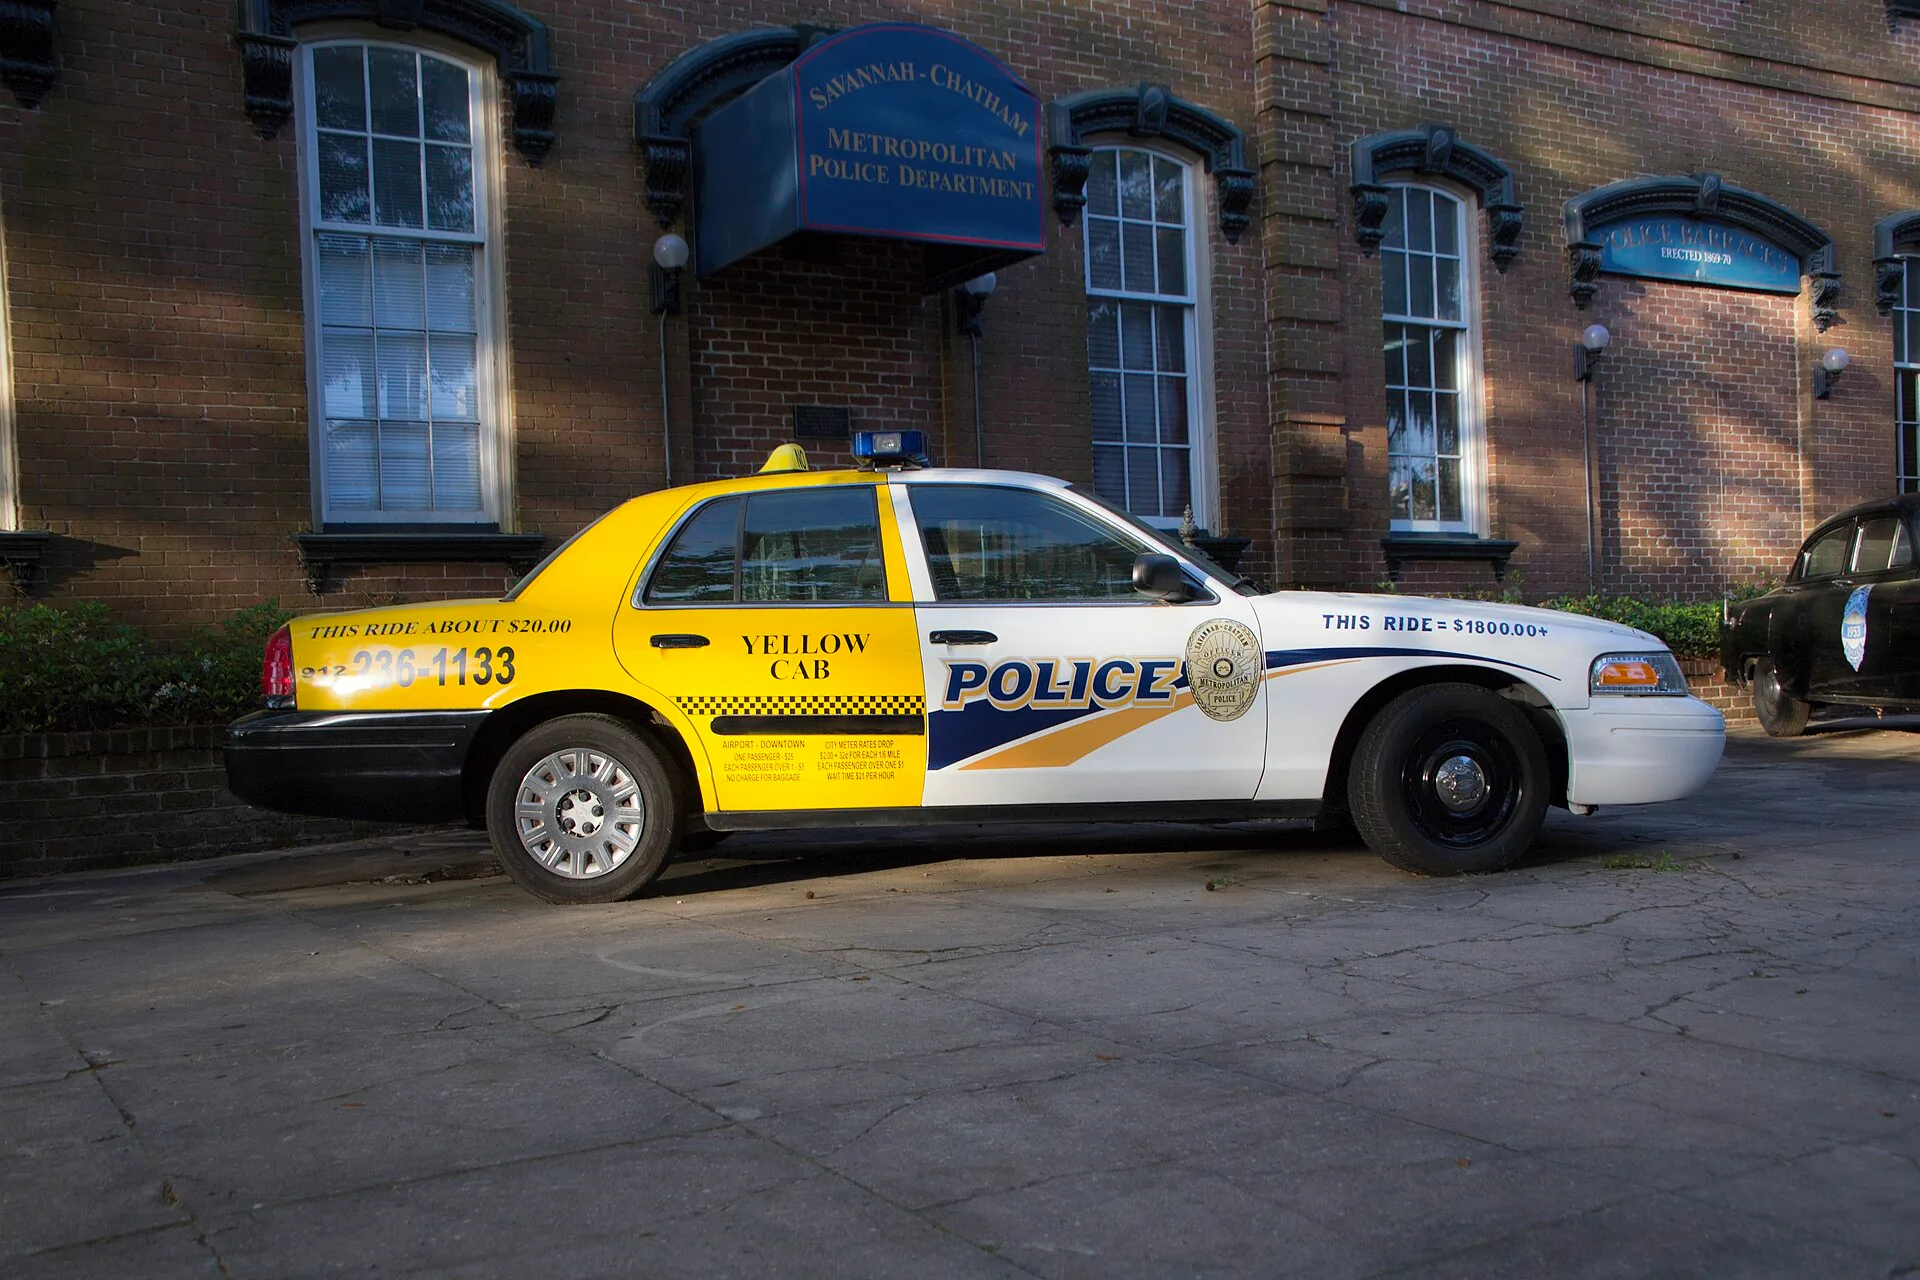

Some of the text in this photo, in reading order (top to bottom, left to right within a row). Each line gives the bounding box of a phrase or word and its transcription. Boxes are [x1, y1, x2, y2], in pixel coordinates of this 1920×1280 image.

[828, 127, 1016, 171] METROPOLITAN
[810, 154, 1035, 200] POLICE DEPARTMENT
[1661, 247, 1701, 262] ERECTED
[311, 618, 572, 639] THIS RIDE ABOUT $20.00
[1323, 614, 1370, 630] THIS
[741, 633, 870, 655] YELLOW
[301, 646, 516, 687] 912 236-1133
[770, 659, 830, 680] CAB
[940, 656, 1183, 711] POLICE
[1200, 675, 1248, 690] METROPOLITAN
[1214, 695, 1236, 703] POLICE
[722, 740, 754, 748] AIRPORT
[760, 740, 805, 748] DOWNTOWN
[825, 741, 837, 749] CITY
[878, 740, 894, 748] DROP
[734, 753, 746, 761] ONE
[747, 753, 780, 761] PASSENGER
[849, 751, 860, 759] FOR
[862, 751, 877, 759] EACH
[724, 763, 739, 771] EACH
[740, 763, 773, 771] PASSENGER
[775, 763, 790, 771] OVER
[817, 762, 832, 770] EACH
[834, 761, 867, 769] PASSENGER
[868, 761, 884, 769] OVER
[885, 761, 897, 769] ONE
[736, 773, 759, 781] CHARGE
[760, 773, 771, 781] FOR
[773, 773, 800, 781] BAGGAGE
[842, 772, 854, 780] TIME
[866, 772, 877, 780] PER
